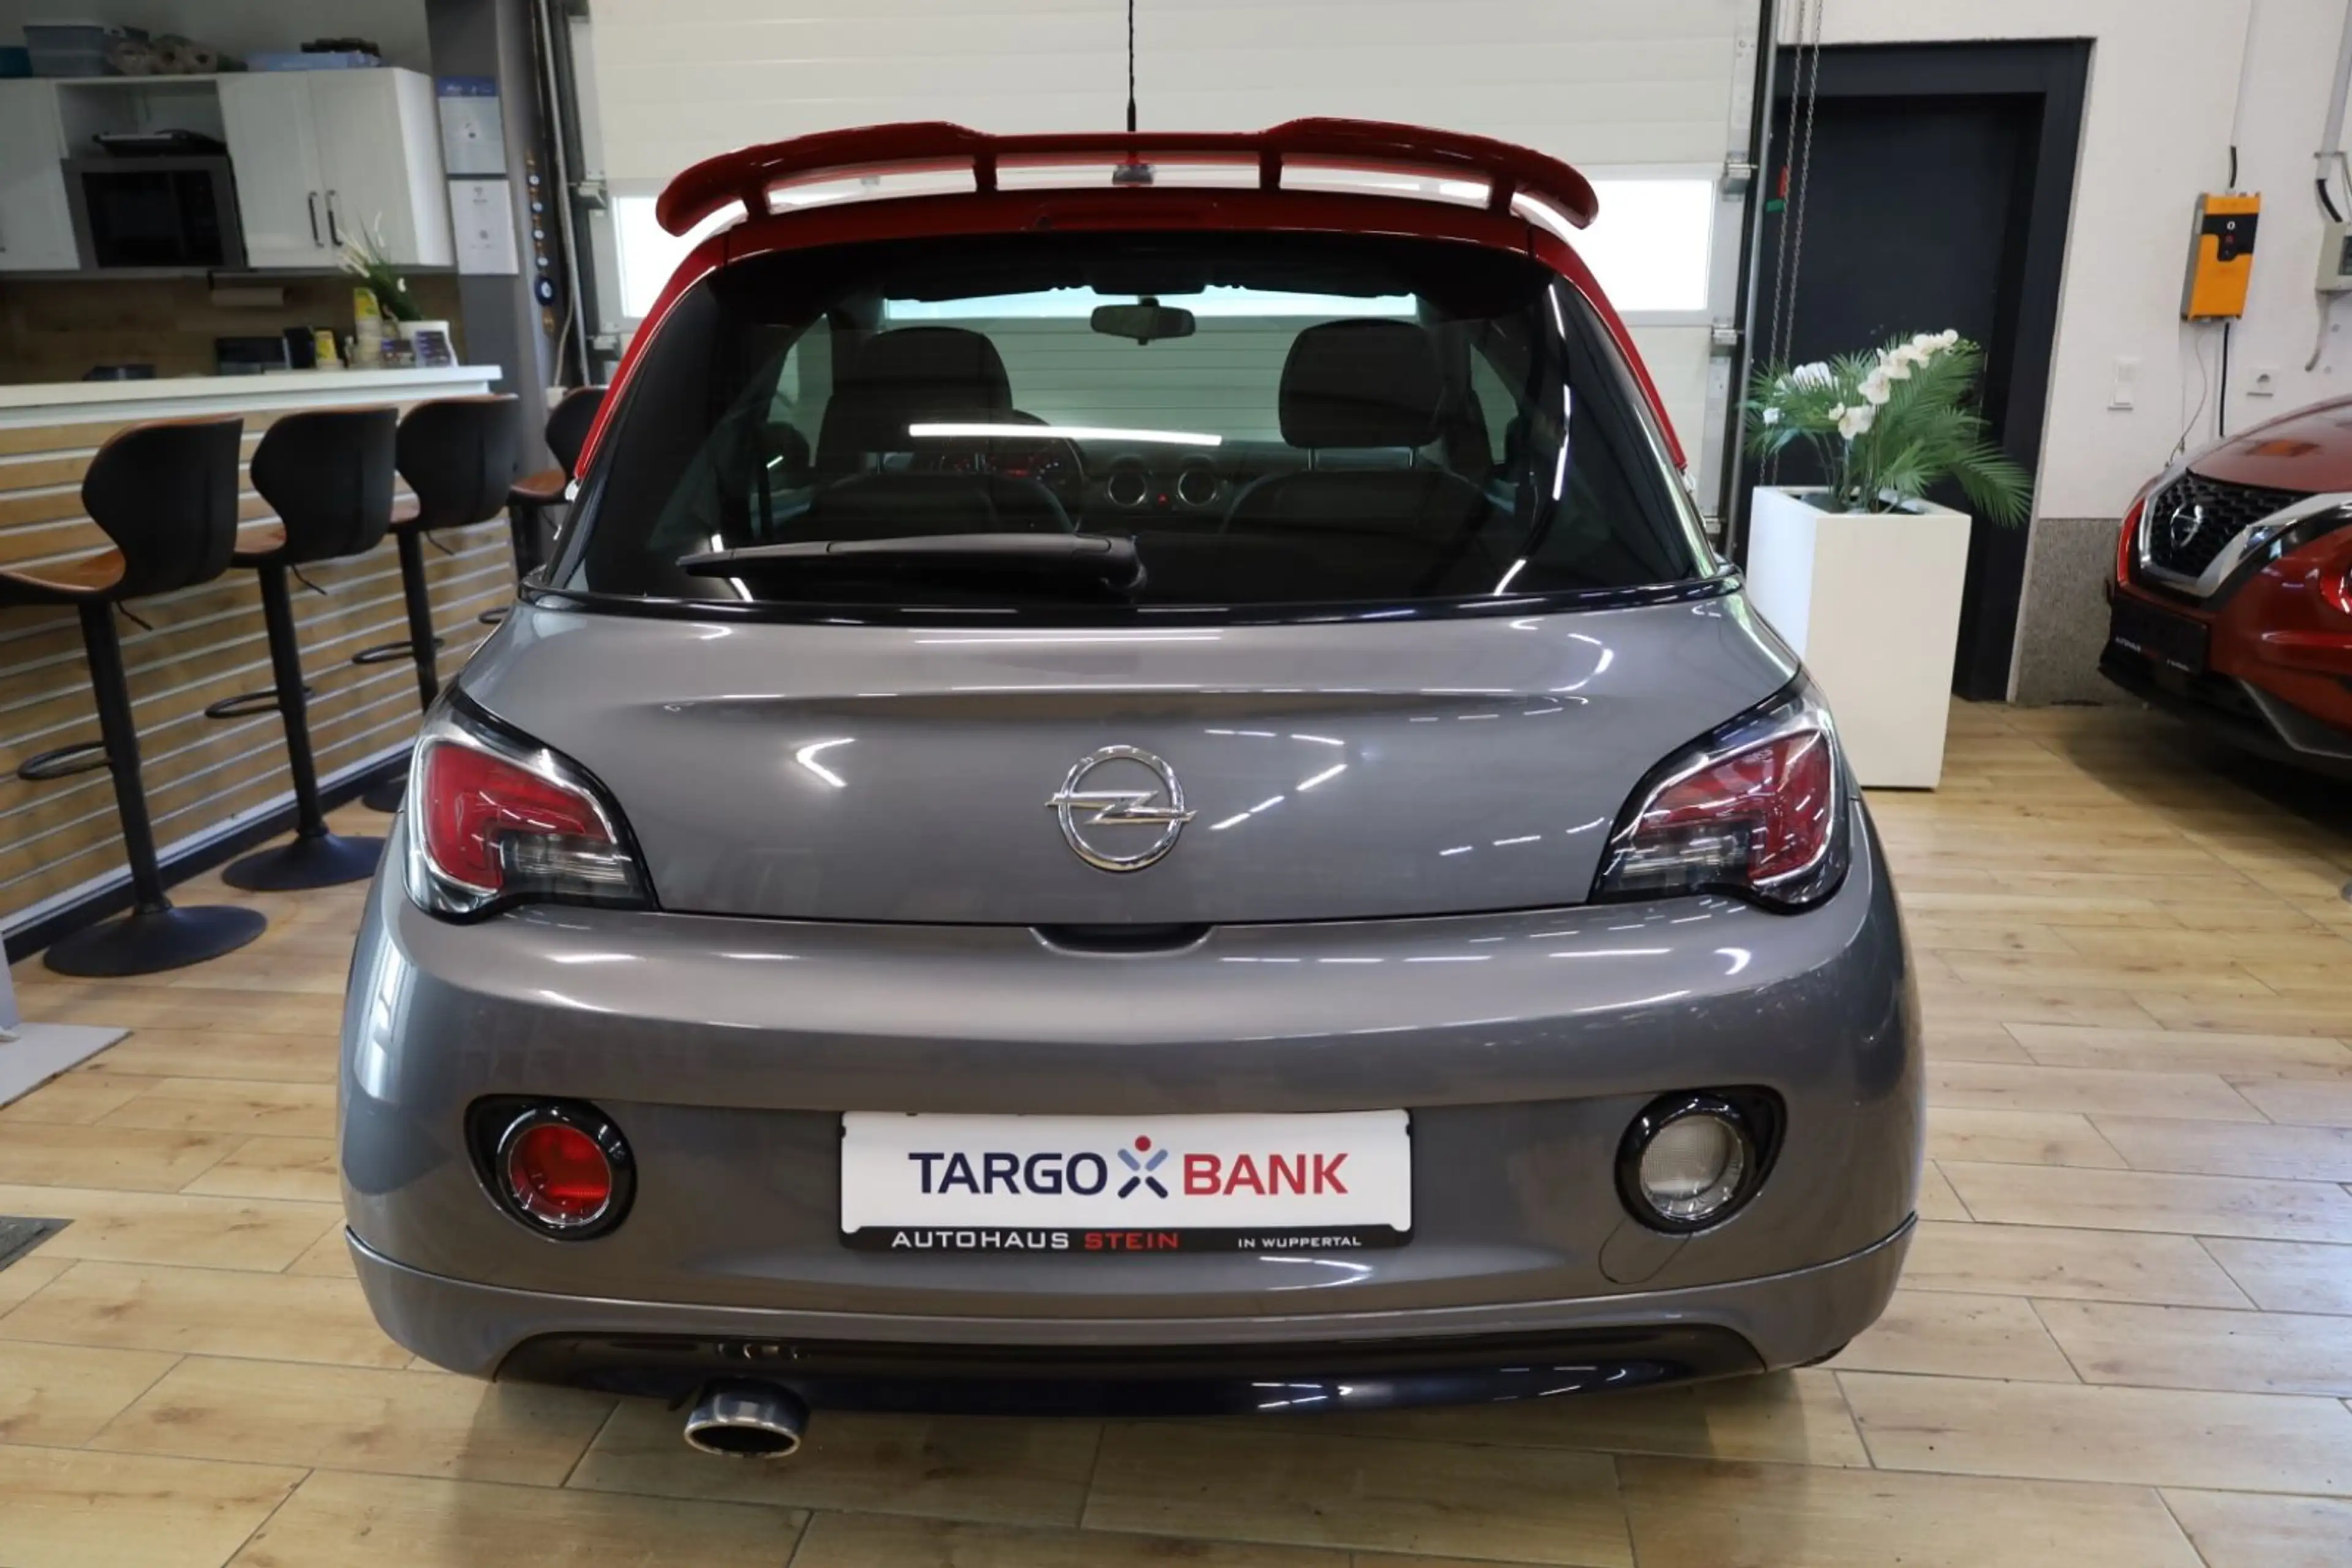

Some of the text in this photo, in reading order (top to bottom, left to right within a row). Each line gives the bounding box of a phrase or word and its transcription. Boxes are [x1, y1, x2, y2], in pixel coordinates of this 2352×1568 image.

[908, 1152, 1348, 1196] TARGO BANK
[891, 1231, 1179, 1250] AUTOHAUS STEIN
[1237, 1235, 1362, 1248] IN WUPPERTAL
